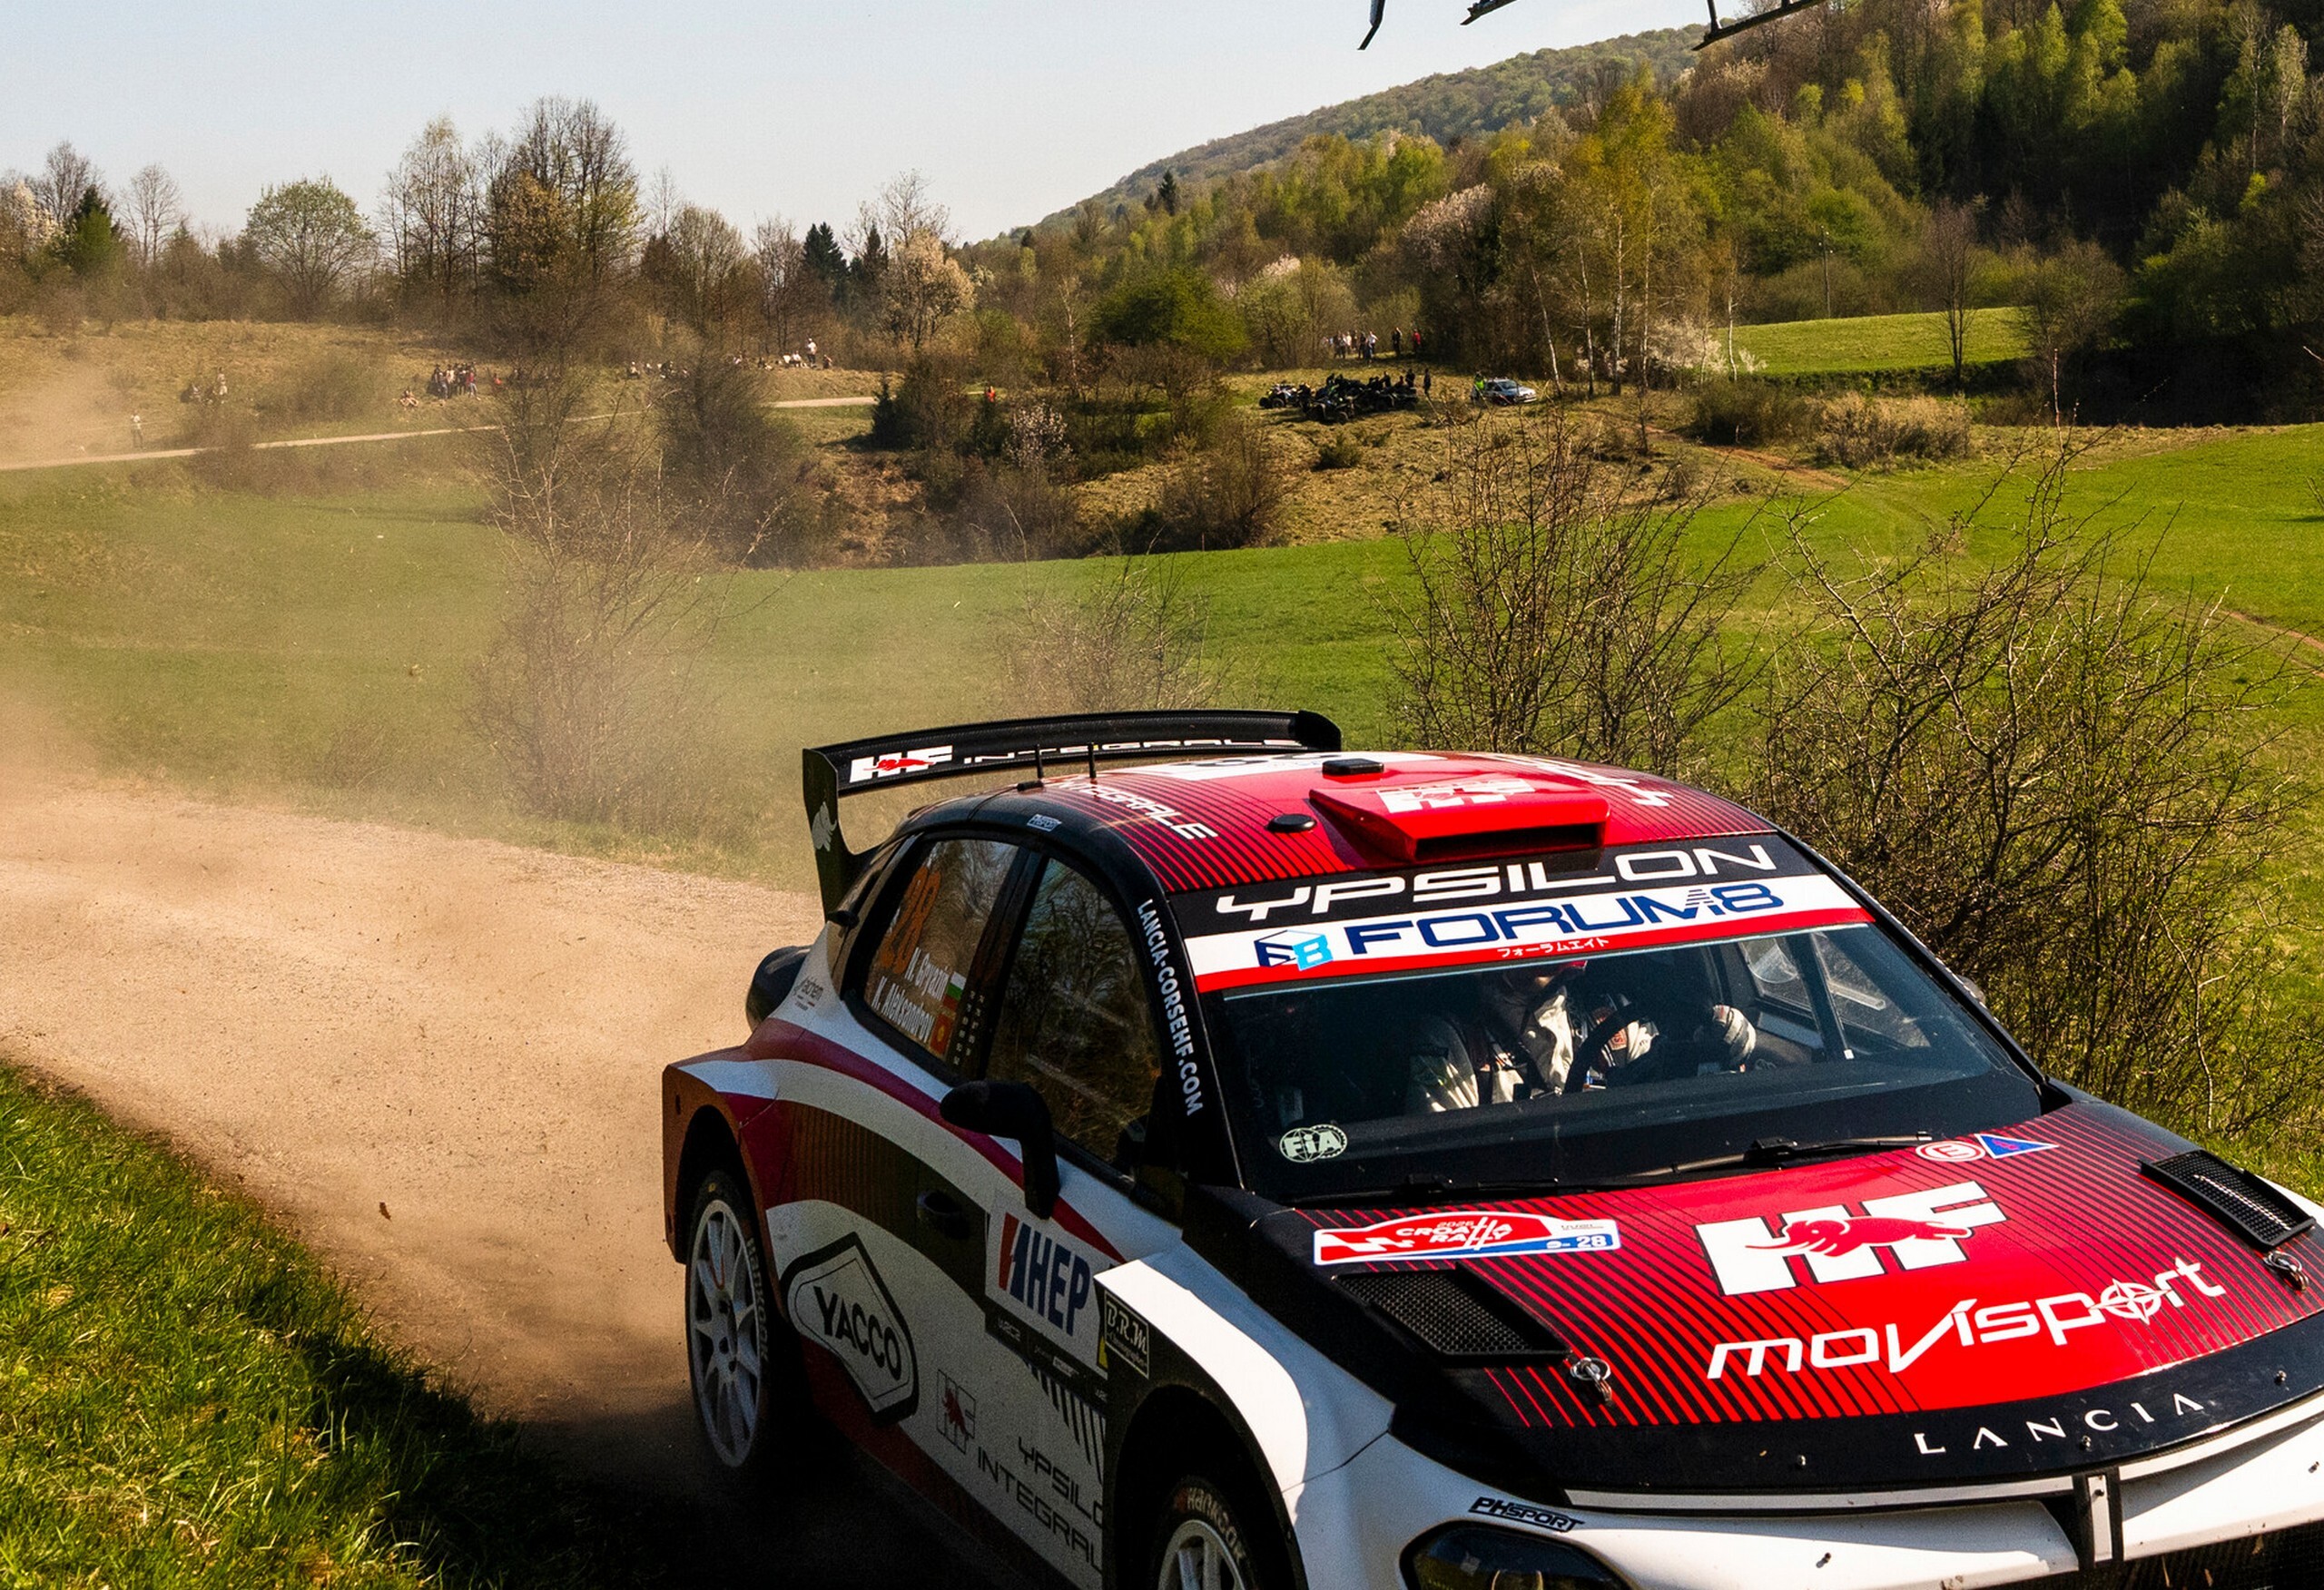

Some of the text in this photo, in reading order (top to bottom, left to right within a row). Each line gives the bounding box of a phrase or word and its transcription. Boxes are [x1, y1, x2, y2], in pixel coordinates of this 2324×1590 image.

[1216, 845, 1777, 921] YPSILON
[1344, 883, 1784, 956] FORUM8
[1497, 937, 1609, 958] フォーラムエイト
[1137, 898, 1203, 1116] LANCIA-CORSEHF.COM
[1576, 1235, 1608, 1248] 28
[1696, 1180, 2007, 1297] HF
[813, 1285, 901, 1381] YACCO
[1707, 1257, 2226, 1379] movisport
[1915, 1392, 2204, 1455] LANCIA
[1467, 1497, 1585, 1532] PHSPORT
